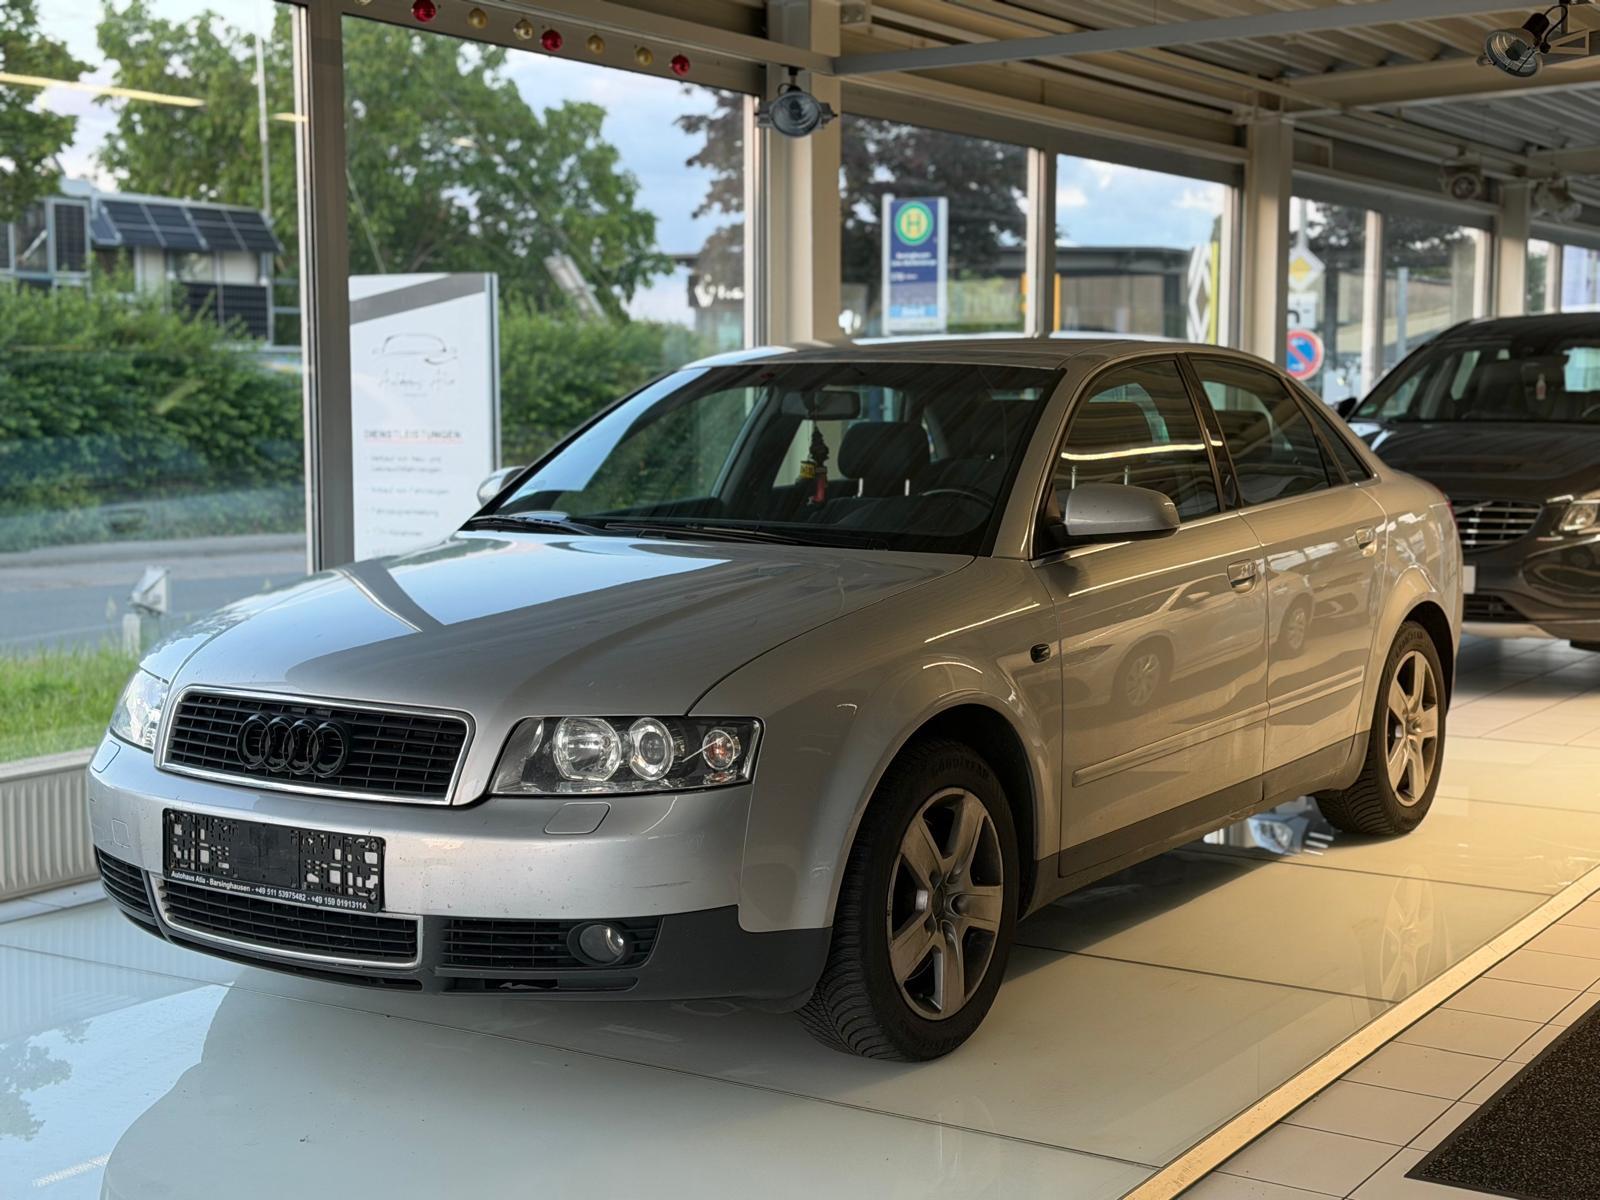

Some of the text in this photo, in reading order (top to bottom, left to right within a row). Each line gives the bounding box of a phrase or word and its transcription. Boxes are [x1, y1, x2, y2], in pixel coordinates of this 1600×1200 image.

[906, 212, 922, 235] H
[170, 870, 195, 882] Autohaus
[209, 878, 251, 892] Barsinghausen
[255, 887, 266, 895] +49
[266, 888, 277, 897] 511
[278, 890, 306, 902] 53975482
[311, 896, 323, 904] +49
[324, 897, 336, 906] 159
[336, 898, 367, 910] 01913114
